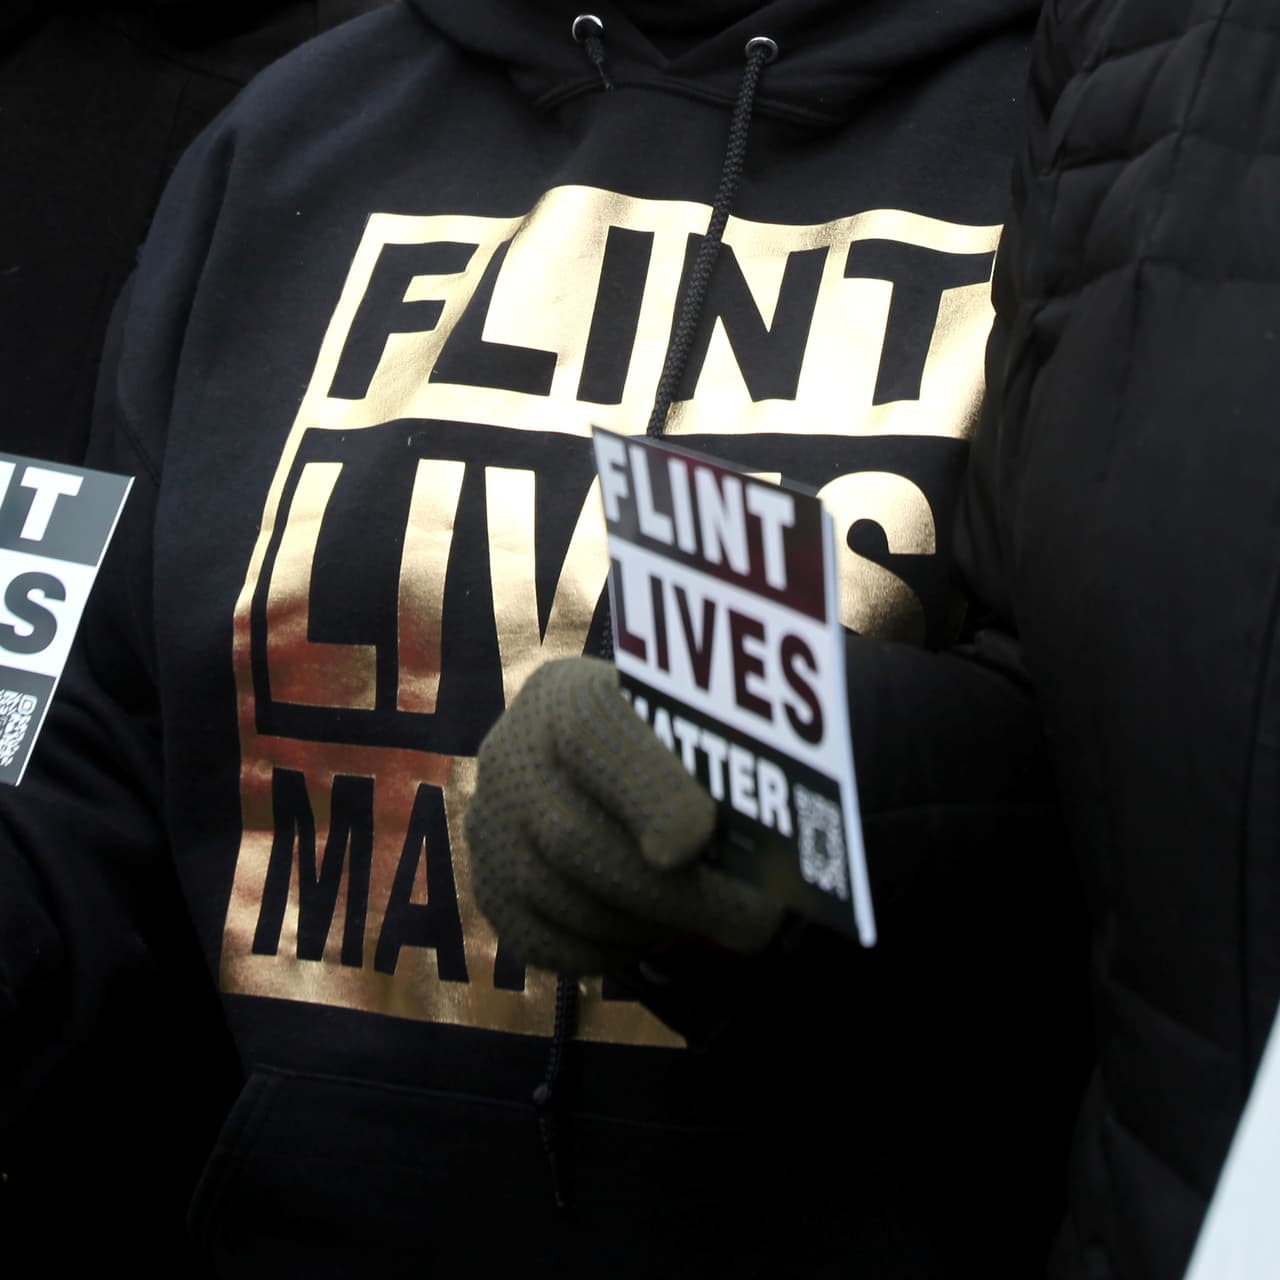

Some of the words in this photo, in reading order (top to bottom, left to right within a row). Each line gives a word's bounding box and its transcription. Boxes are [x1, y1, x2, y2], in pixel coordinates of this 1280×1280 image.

[327, 224, 997, 407] FLINT
[266, 455, 937, 715] LIVS
[593, 428, 796, 593] FLINT
[610, 557, 825, 747] LIVES
[621, 686, 794, 839] TTER
